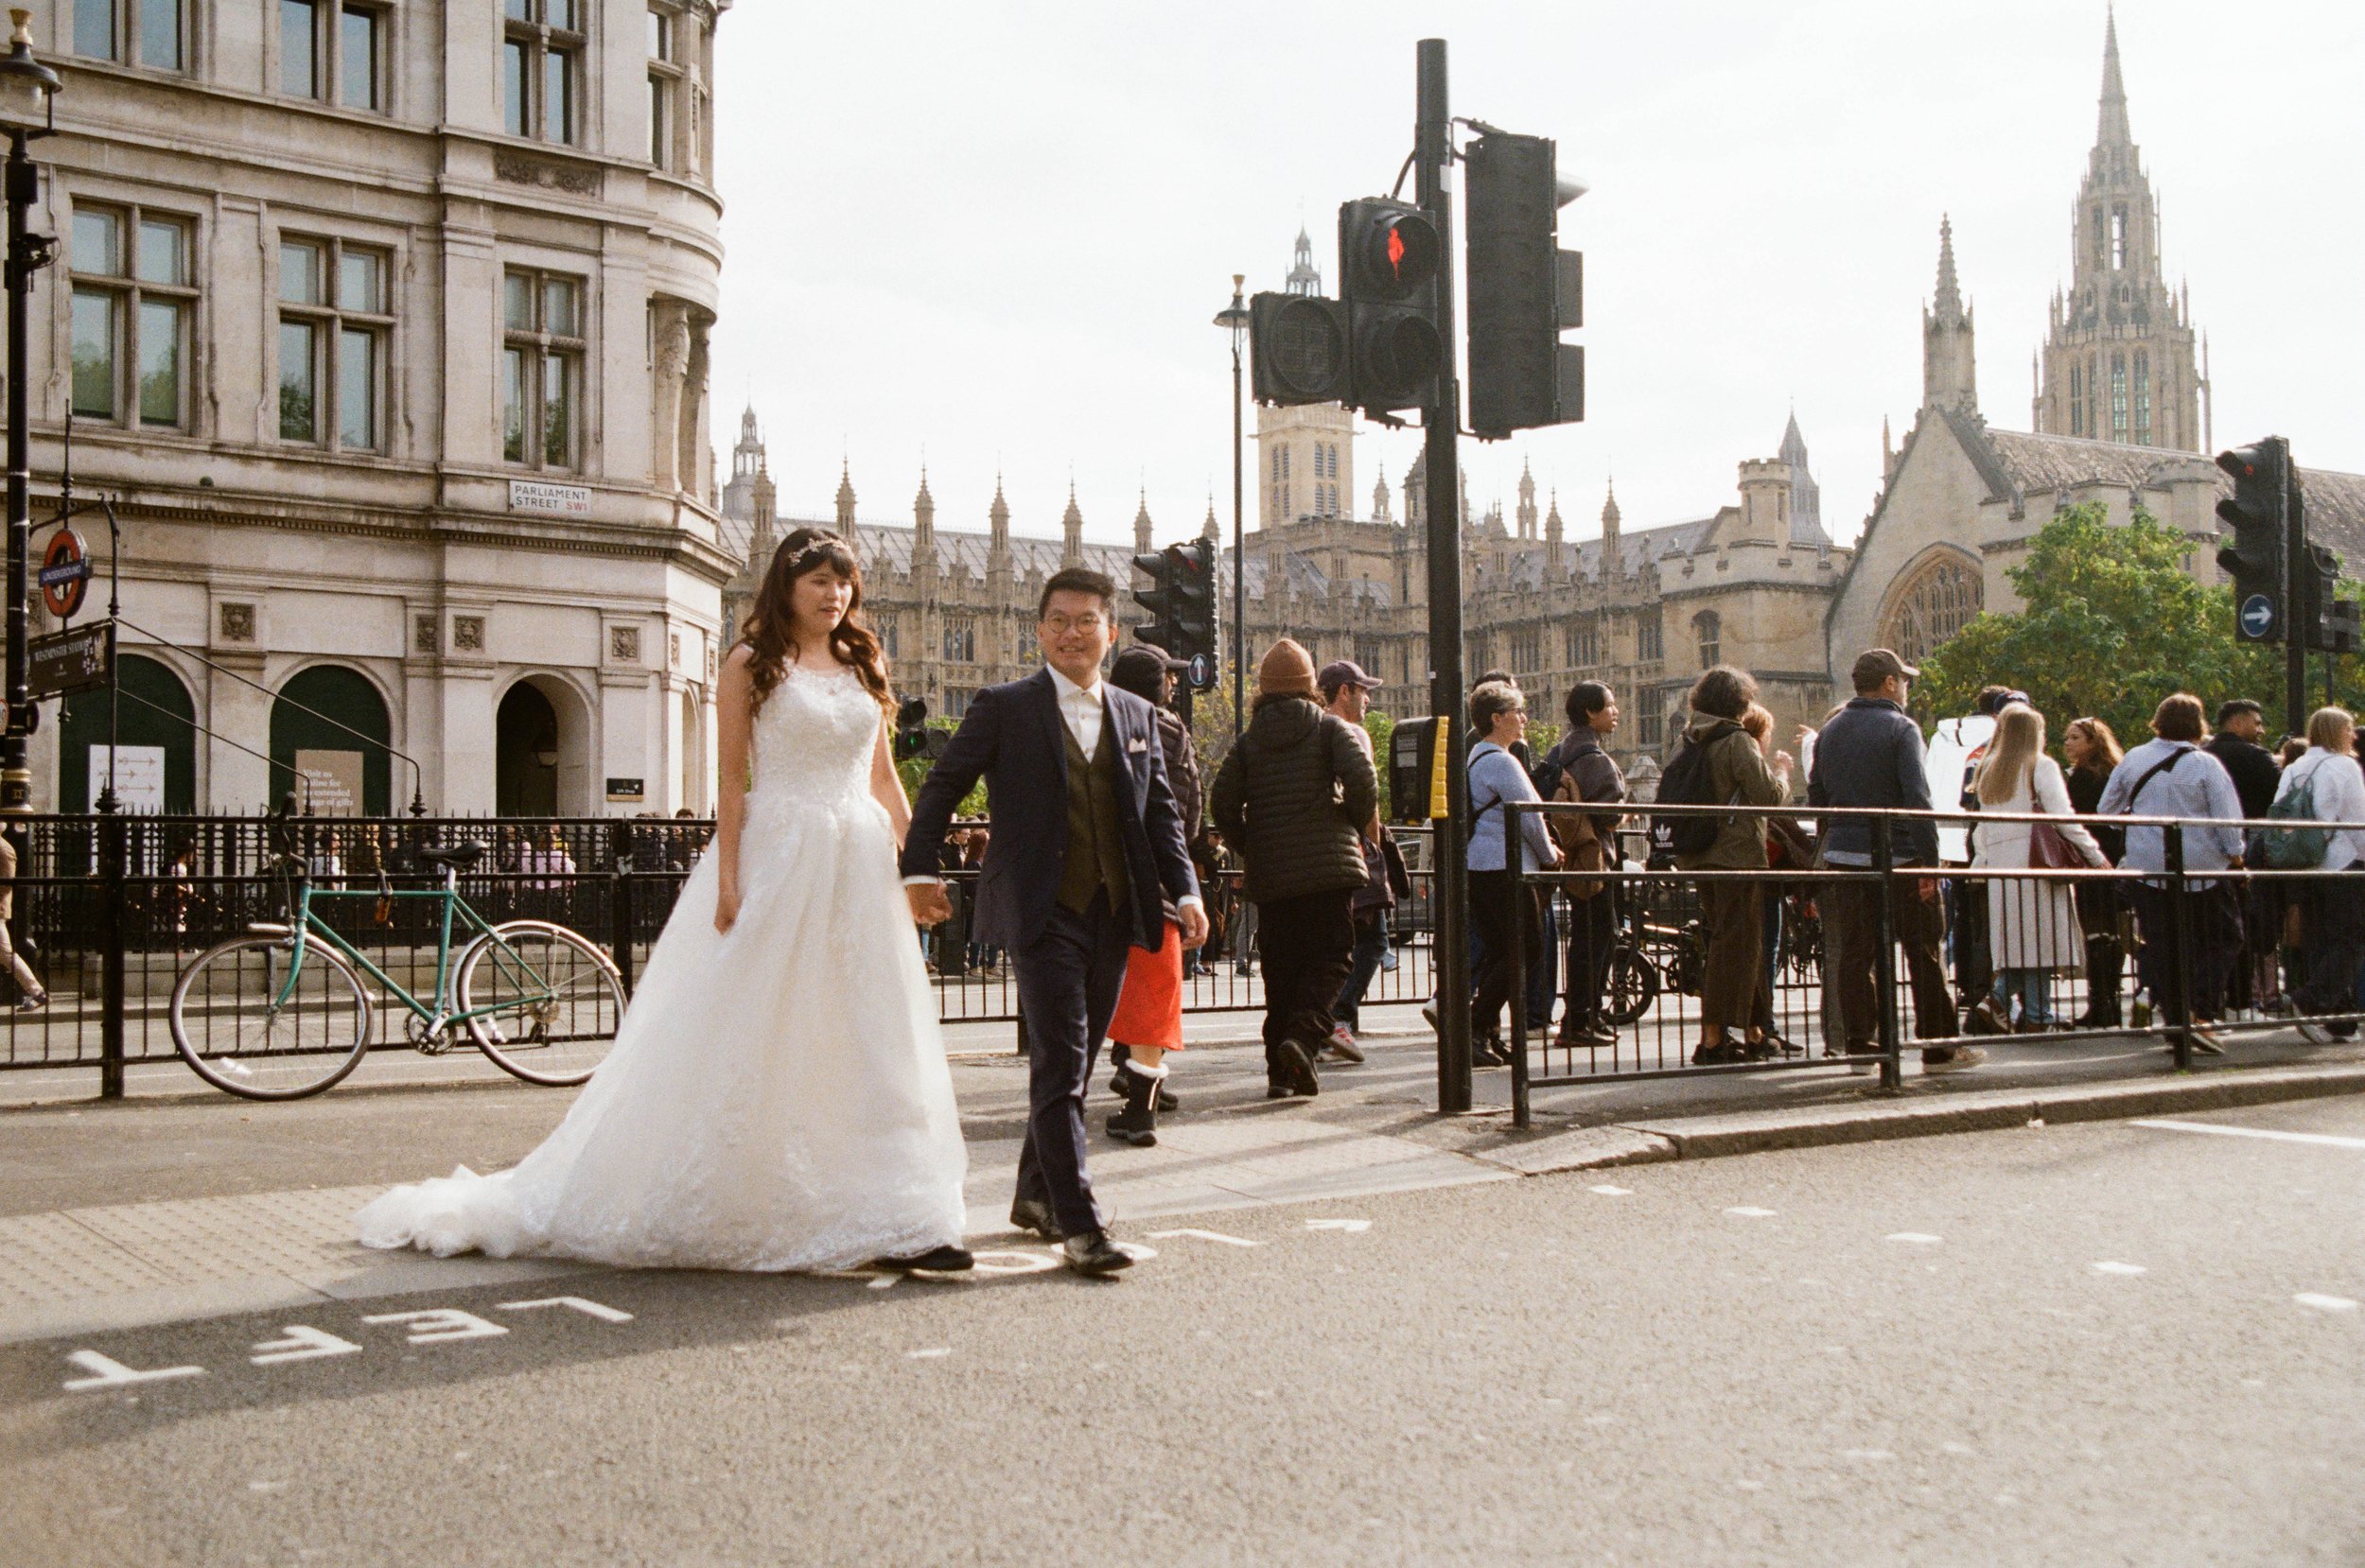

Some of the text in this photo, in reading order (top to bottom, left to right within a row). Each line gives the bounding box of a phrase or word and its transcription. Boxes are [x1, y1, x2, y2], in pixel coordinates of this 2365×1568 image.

[515, 485, 586, 500] PARLIAMENT
[516, 497, 558, 509] STREET
[43, 565, 81, 582] UNDERGROUND
[314, 788, 350, 796] extended
[63, 1296, 635, 1390] LEFT
